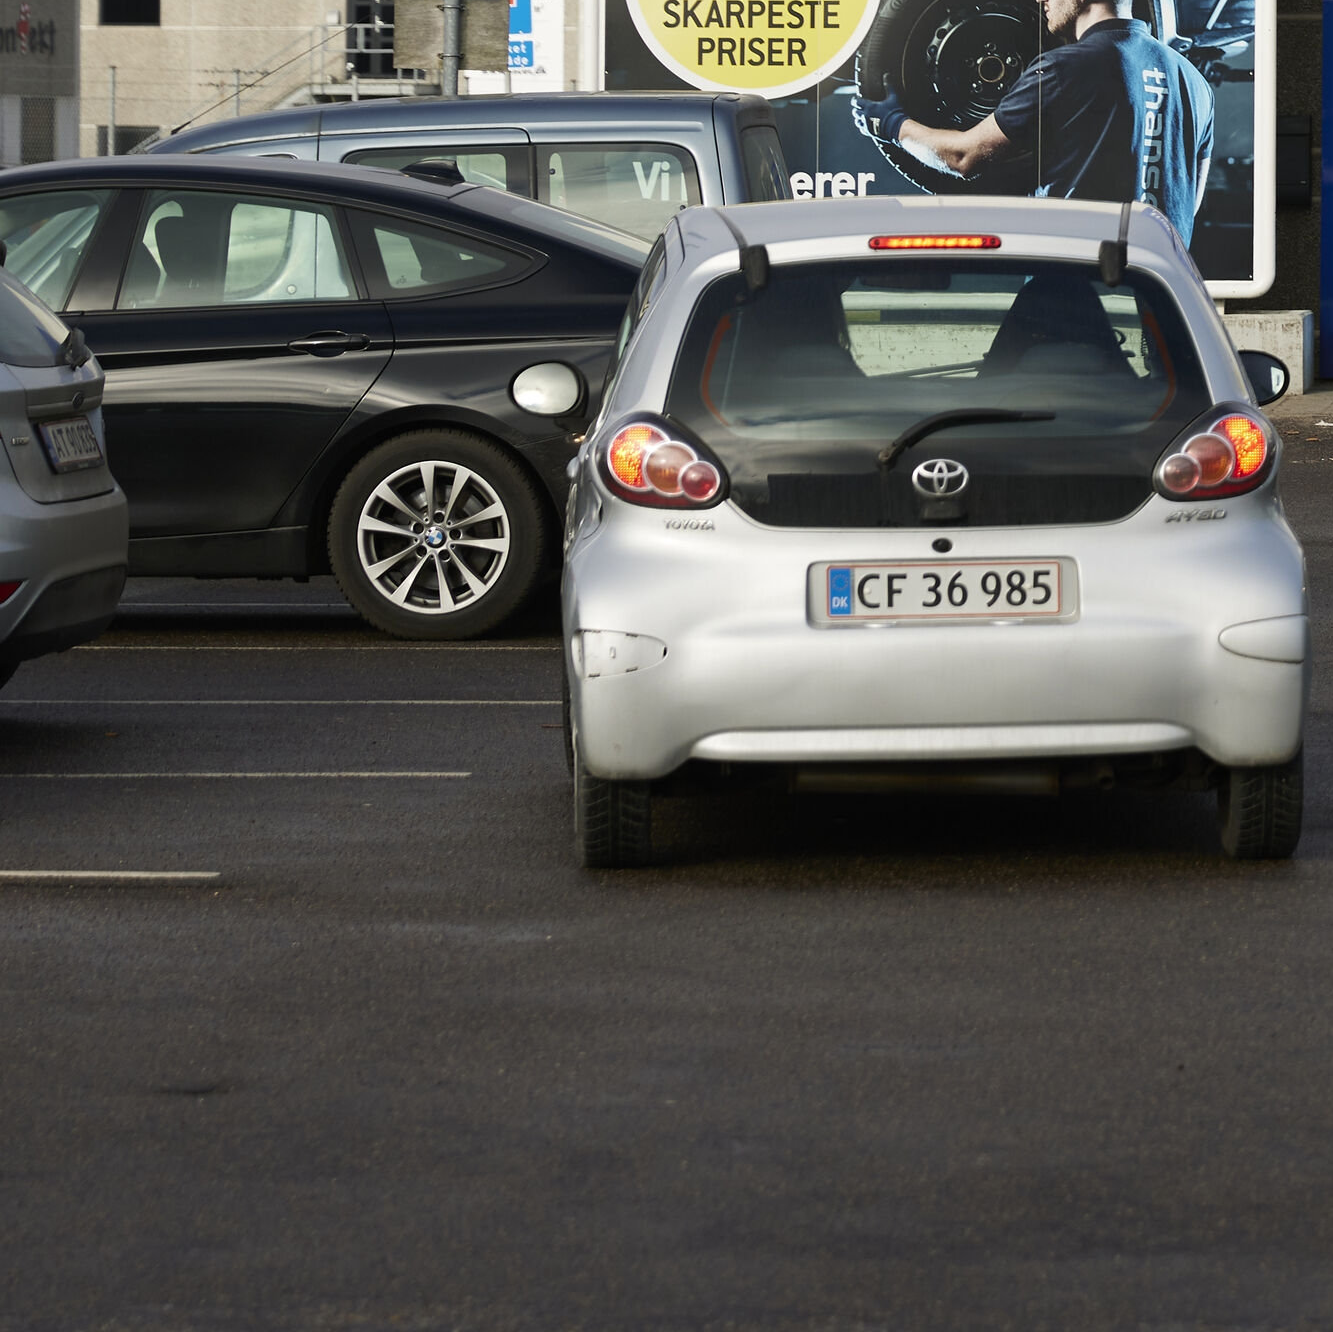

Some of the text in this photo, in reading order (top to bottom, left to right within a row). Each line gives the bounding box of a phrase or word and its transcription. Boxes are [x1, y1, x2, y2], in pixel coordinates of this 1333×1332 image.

[663, 0, 840, 29] SKARPESTE
[697, 38, 807, 66] PRISER
[633, 161, 670, 201] Vi
[664, 519, 716, 530] TOYOTA
[1165, 508, 1228, 523] AYGO
[832, 596, 848, 608] DK
[857, 570, 1052, 608] CF 36 985
